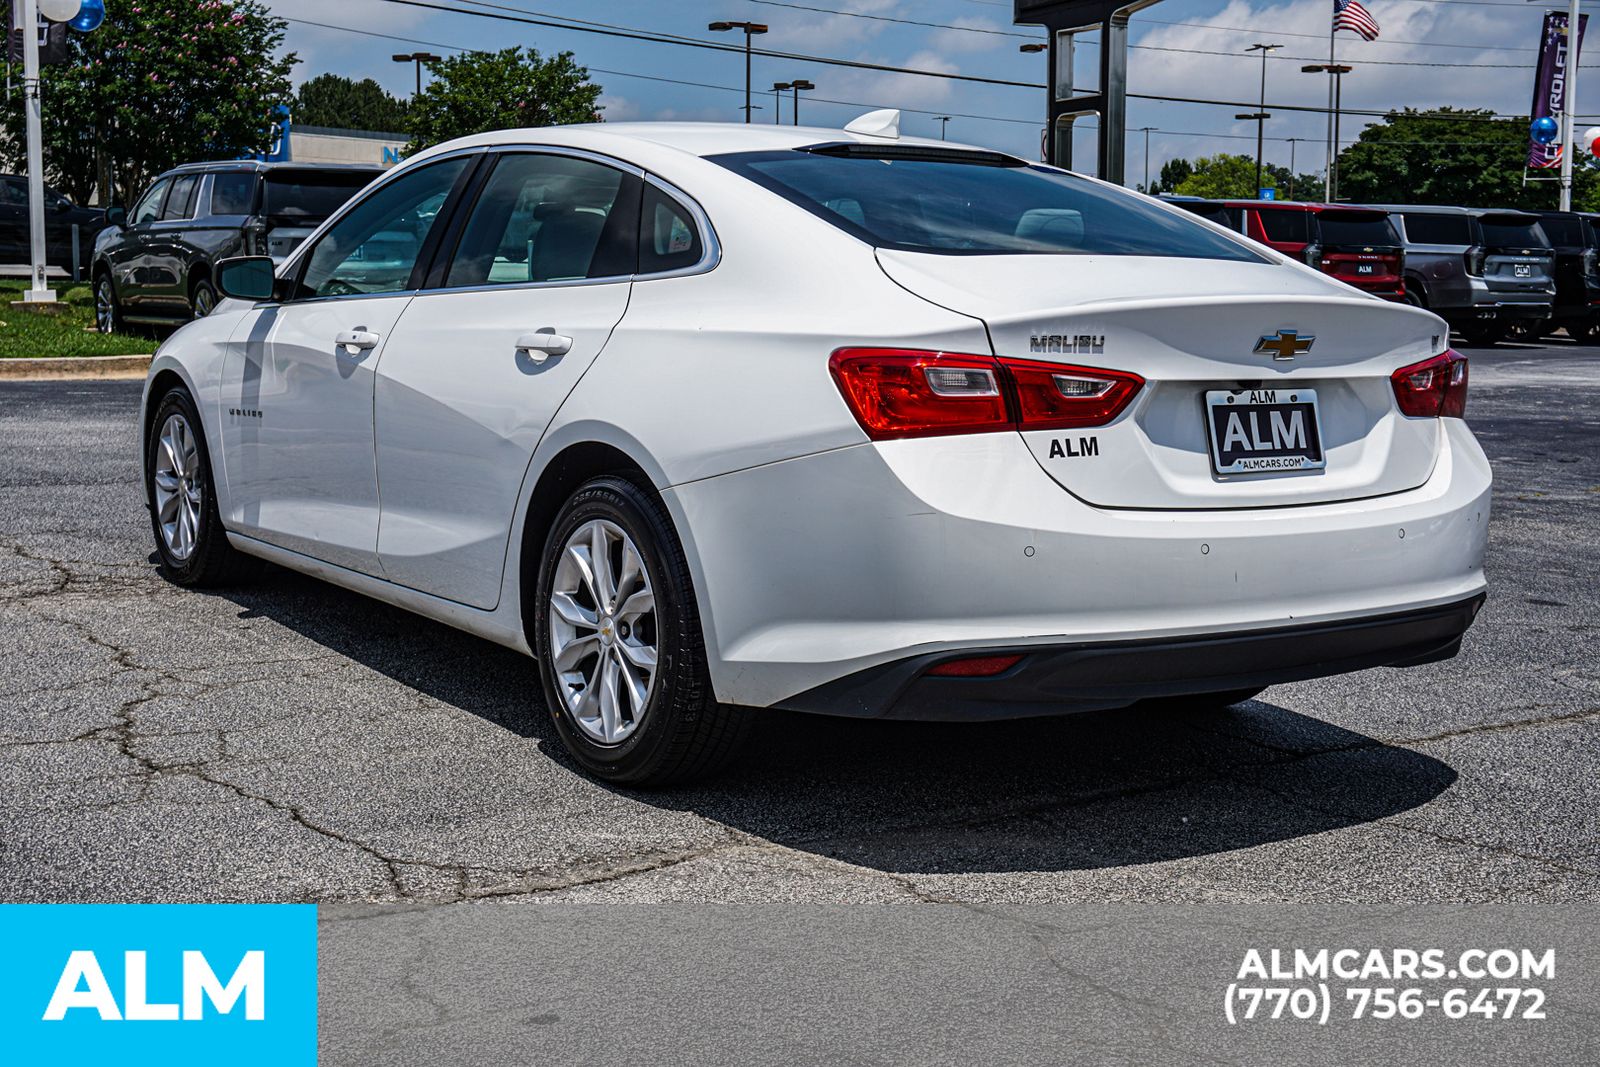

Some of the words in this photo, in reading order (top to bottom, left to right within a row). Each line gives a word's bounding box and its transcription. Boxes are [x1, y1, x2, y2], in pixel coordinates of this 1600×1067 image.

[1544, 42, 1568, 160] CROLET
[1358, 265, 1373, 273] ALM
[1029, 335, 1105, 350] MALIBU
[1249, 390, 1277, 404] ALM
[1223, 410, 1308, 452] ALM
[1049, 436, 1099, 459] ALM
[1242, 459, 1302, 469] ALMCARS.COM
